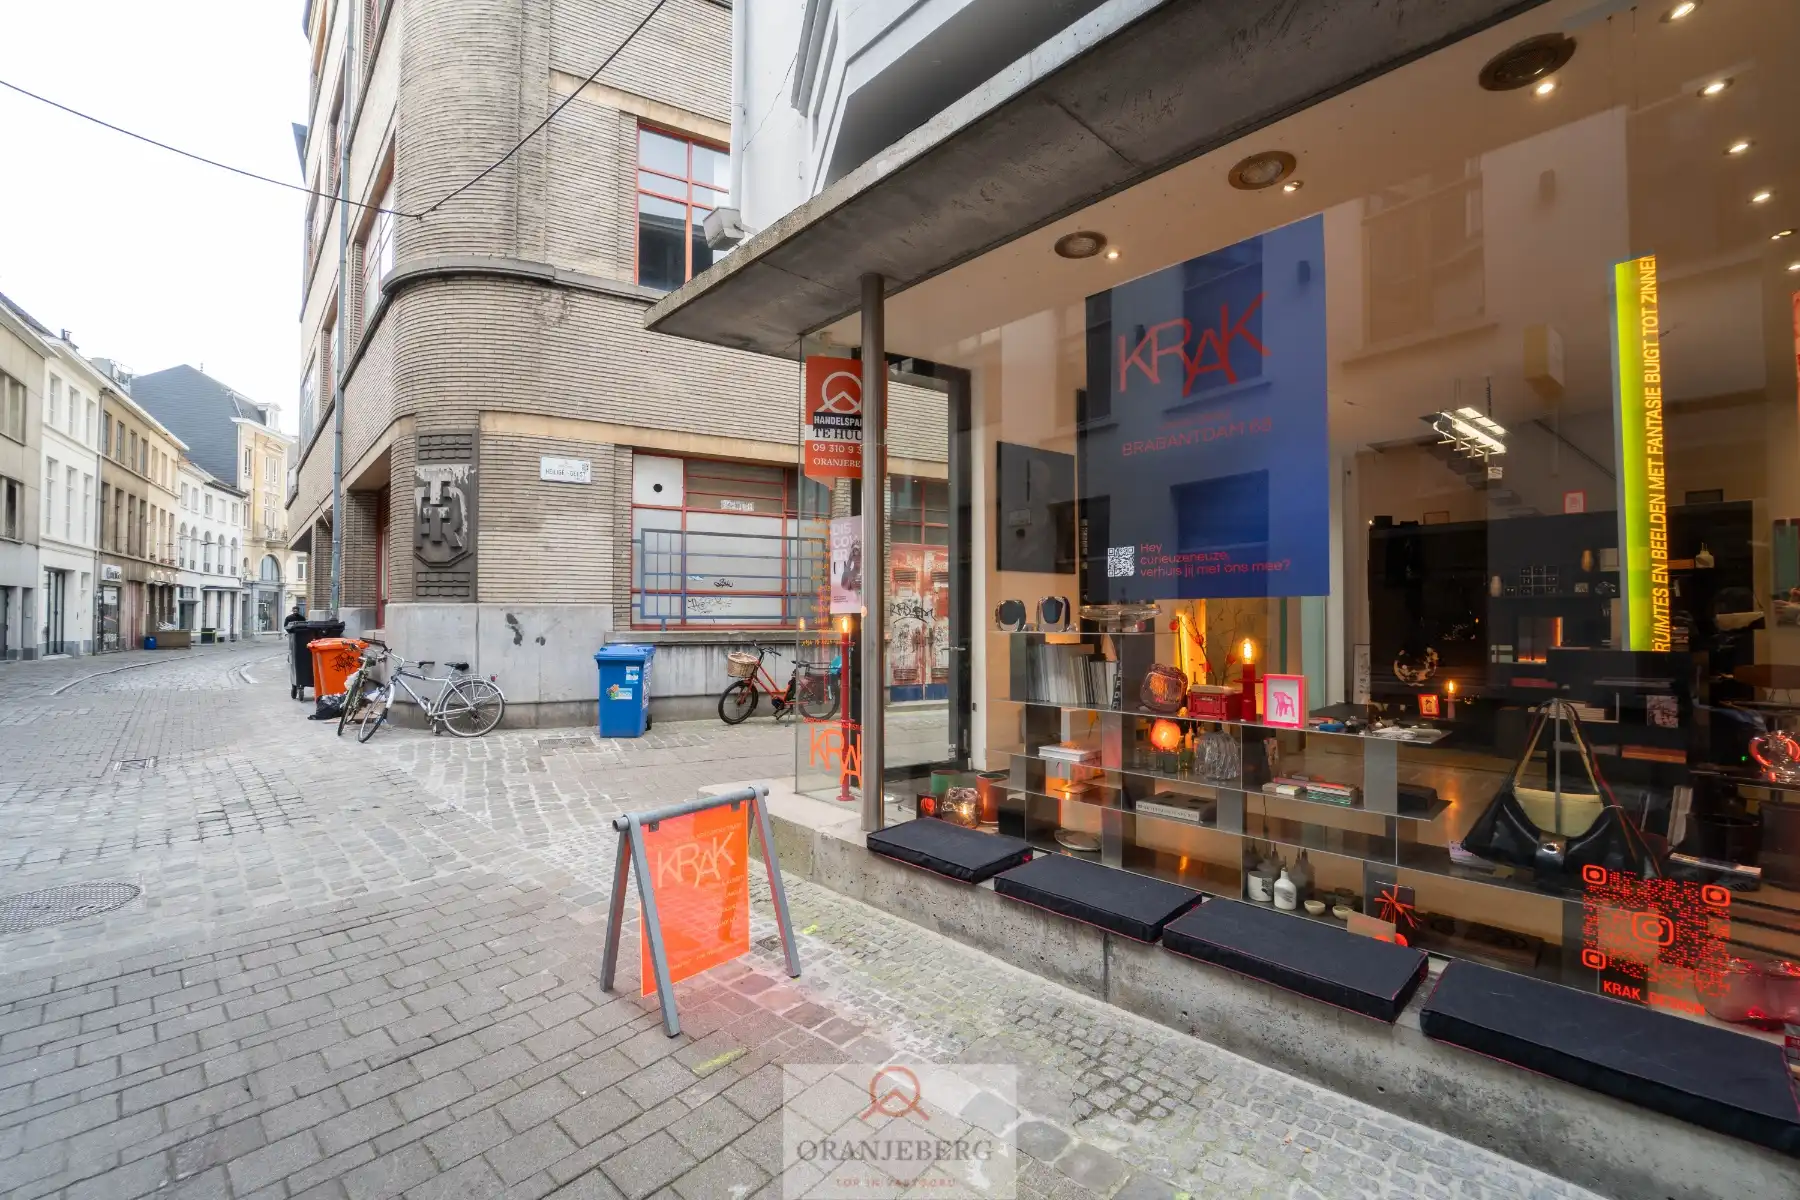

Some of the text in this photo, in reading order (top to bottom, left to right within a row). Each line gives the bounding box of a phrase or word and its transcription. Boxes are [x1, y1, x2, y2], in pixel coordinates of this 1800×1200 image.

[1641, 308, 1659, 340] TOT
[1118, 292, 1273, 397] KRAK
[1642, 342, 1661, 383] BUIGT
[812, 428, 831, 439] TE
[1644, 387, 1664, 455] FANTASIE
[812, 443, 826, 452] 09
[828, 444, 845, 453] 310
[1121, 420, 1245, 457] BRABANTDAM
[1648, 459, 1666, 489] MET
[1649, 491, 1668, 559] BEELDEN
[1140, 543, 1163, 554] Hey
[1140, 564, 1183, 578] verhuis
[1197, 563, 1221, 575] met
[1224, 562, 1249, 573] ons
[1252, 559, 1291, 573] mee?
[1651, 560, 1670, 584] EN
[1652, 589, 1671, 652] RUIMTES
[657, 832, 736, 888] KRAK
